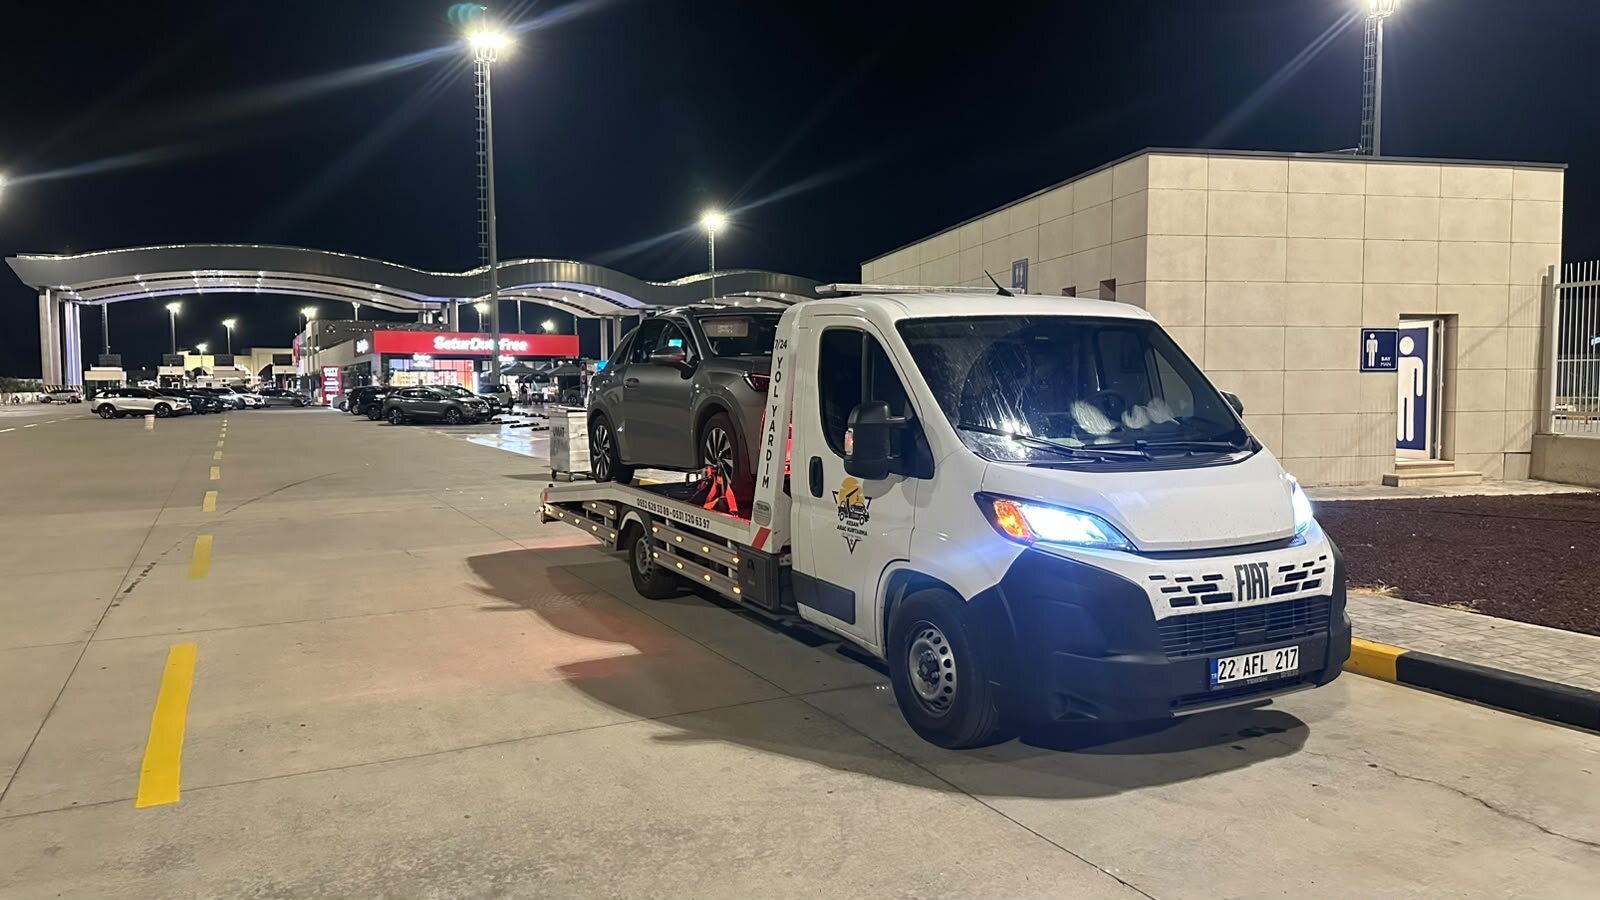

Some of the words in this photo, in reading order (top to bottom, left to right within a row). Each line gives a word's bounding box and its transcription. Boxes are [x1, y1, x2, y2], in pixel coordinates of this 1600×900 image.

[774, 339, 788, 350] 7/24
[773, 357, 783, 398] YOL
[762, 405, 778, 489] YARDIM
[702, 519, 710, 530] 97
[1233, 561, 1269, 602] FIAT
[1218, 658, 1236, 681] 22
[1243, 654, 1268, 678] AFL
[1275, 648, 1298, 670] 217
